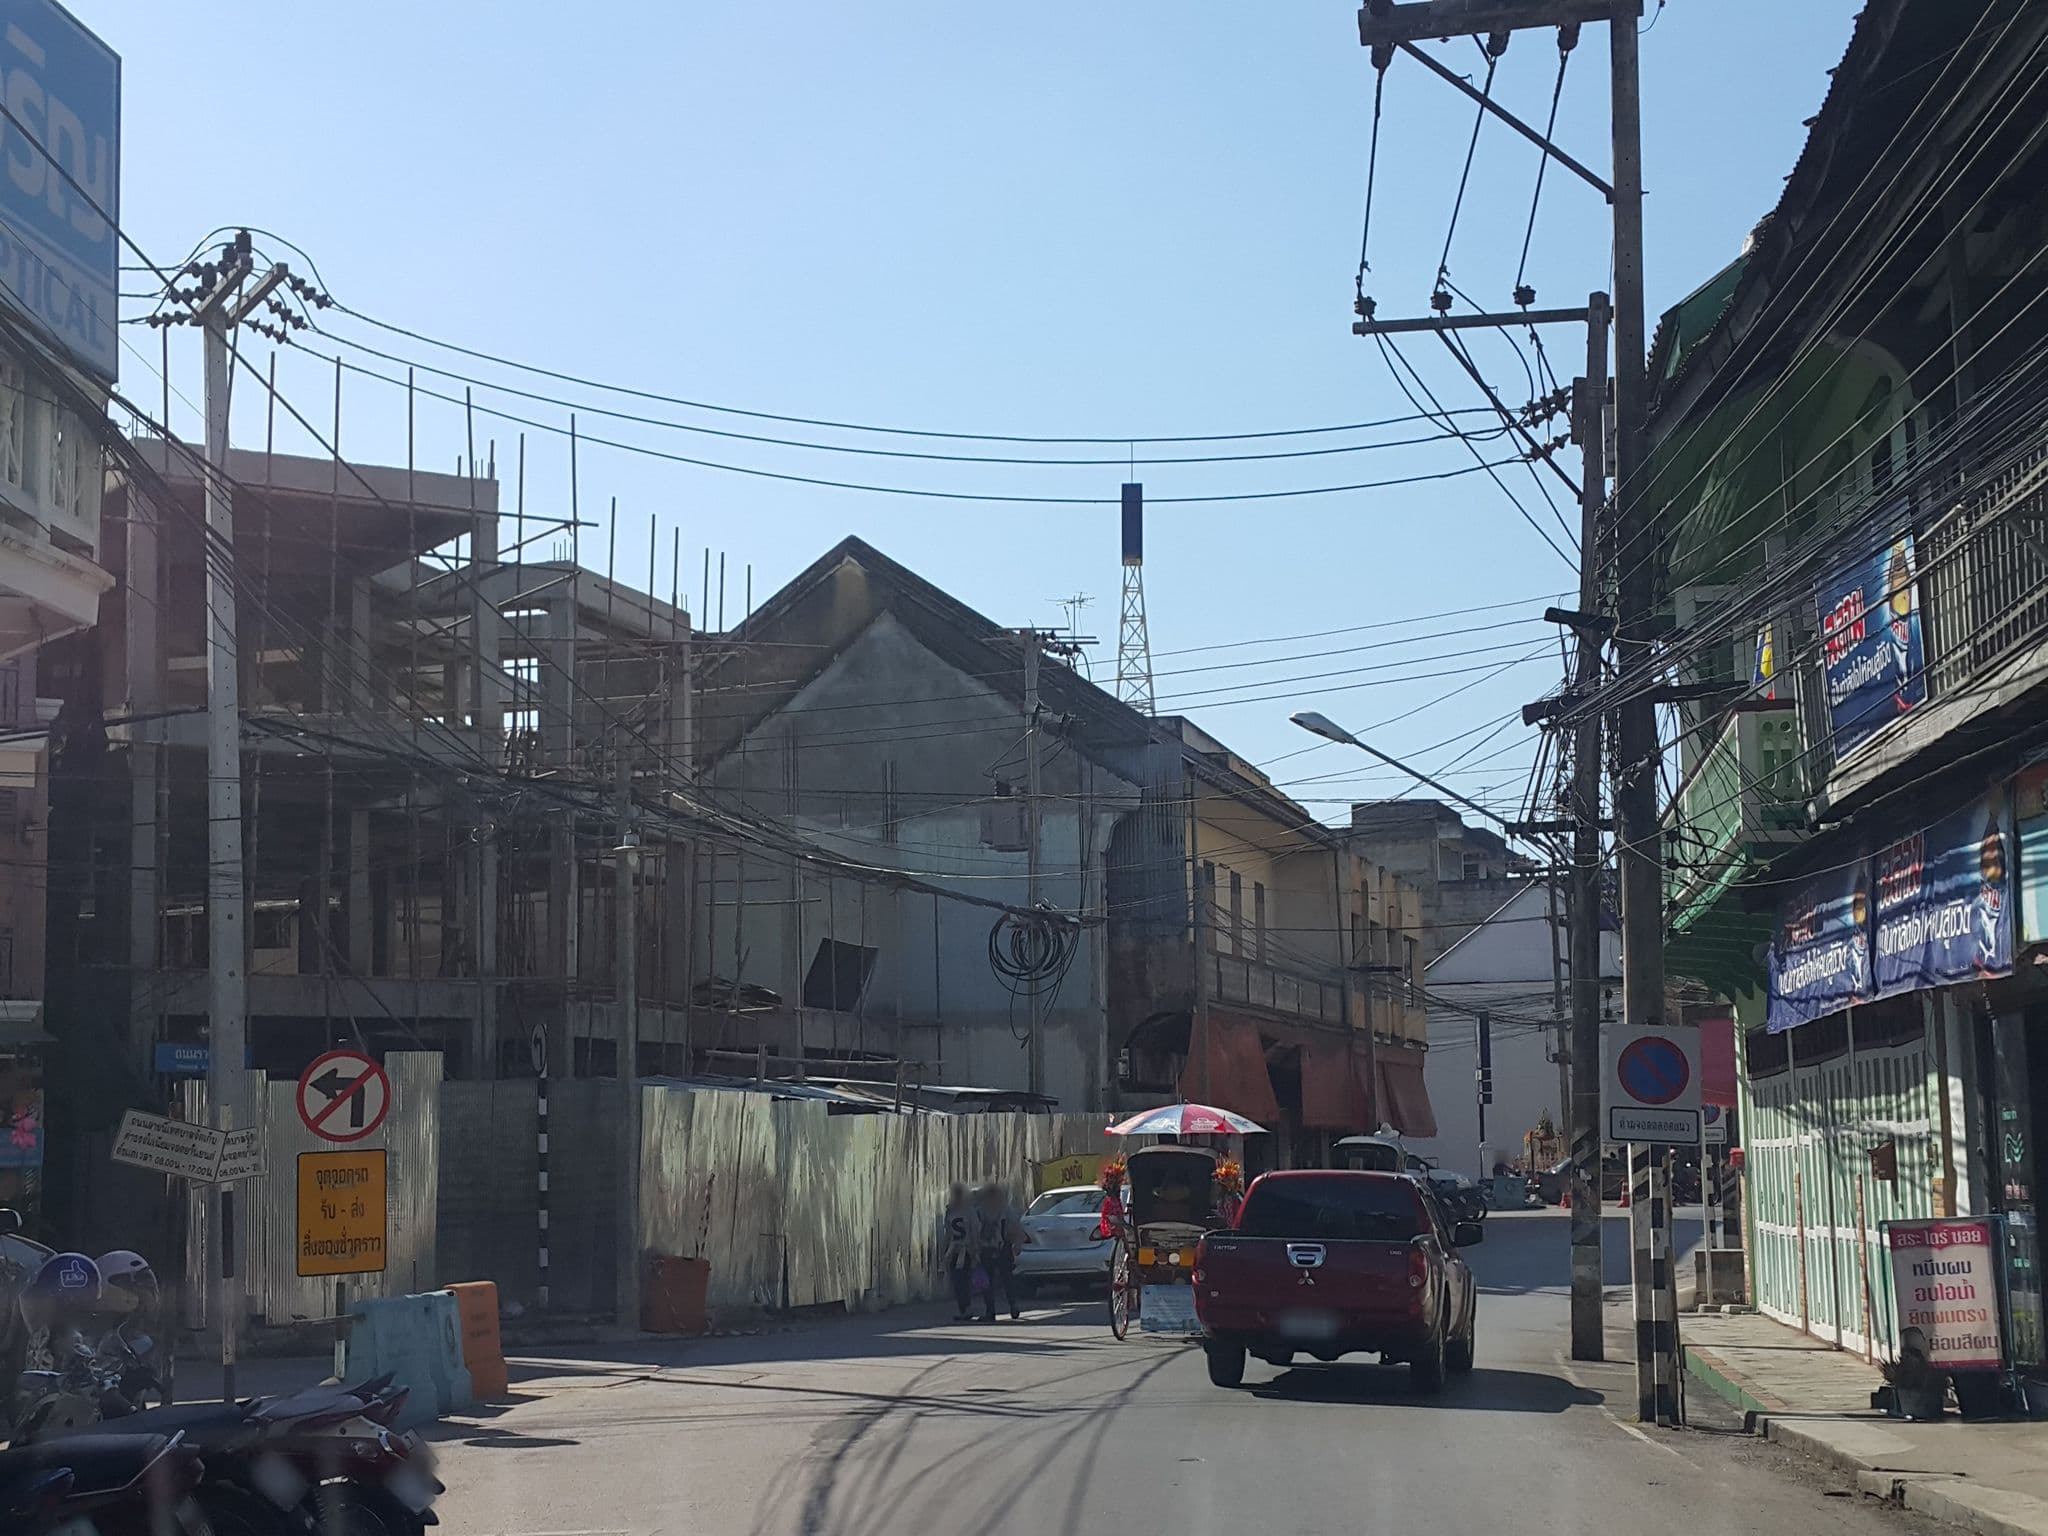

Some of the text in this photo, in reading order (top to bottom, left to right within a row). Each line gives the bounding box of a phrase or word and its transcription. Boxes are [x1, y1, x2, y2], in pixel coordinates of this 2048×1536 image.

[321, 1199, 336, 1219] รับ
[351, 1197, 365, 1218] ส่ง
[303, 1226, 381, 1256] สิ่งของชั่วคราว
[1897, 1231, 1921, 1246] สระ
[1912, 1258, 1972, 1277] หนีบผม
[1914, 1279, 1976, 1302] อบไอน้ำ
[1908, 1308, 1988, 1325] ยืดผมตรง
[1929, 1332, 1999, 1351] ย้อมสีผม
